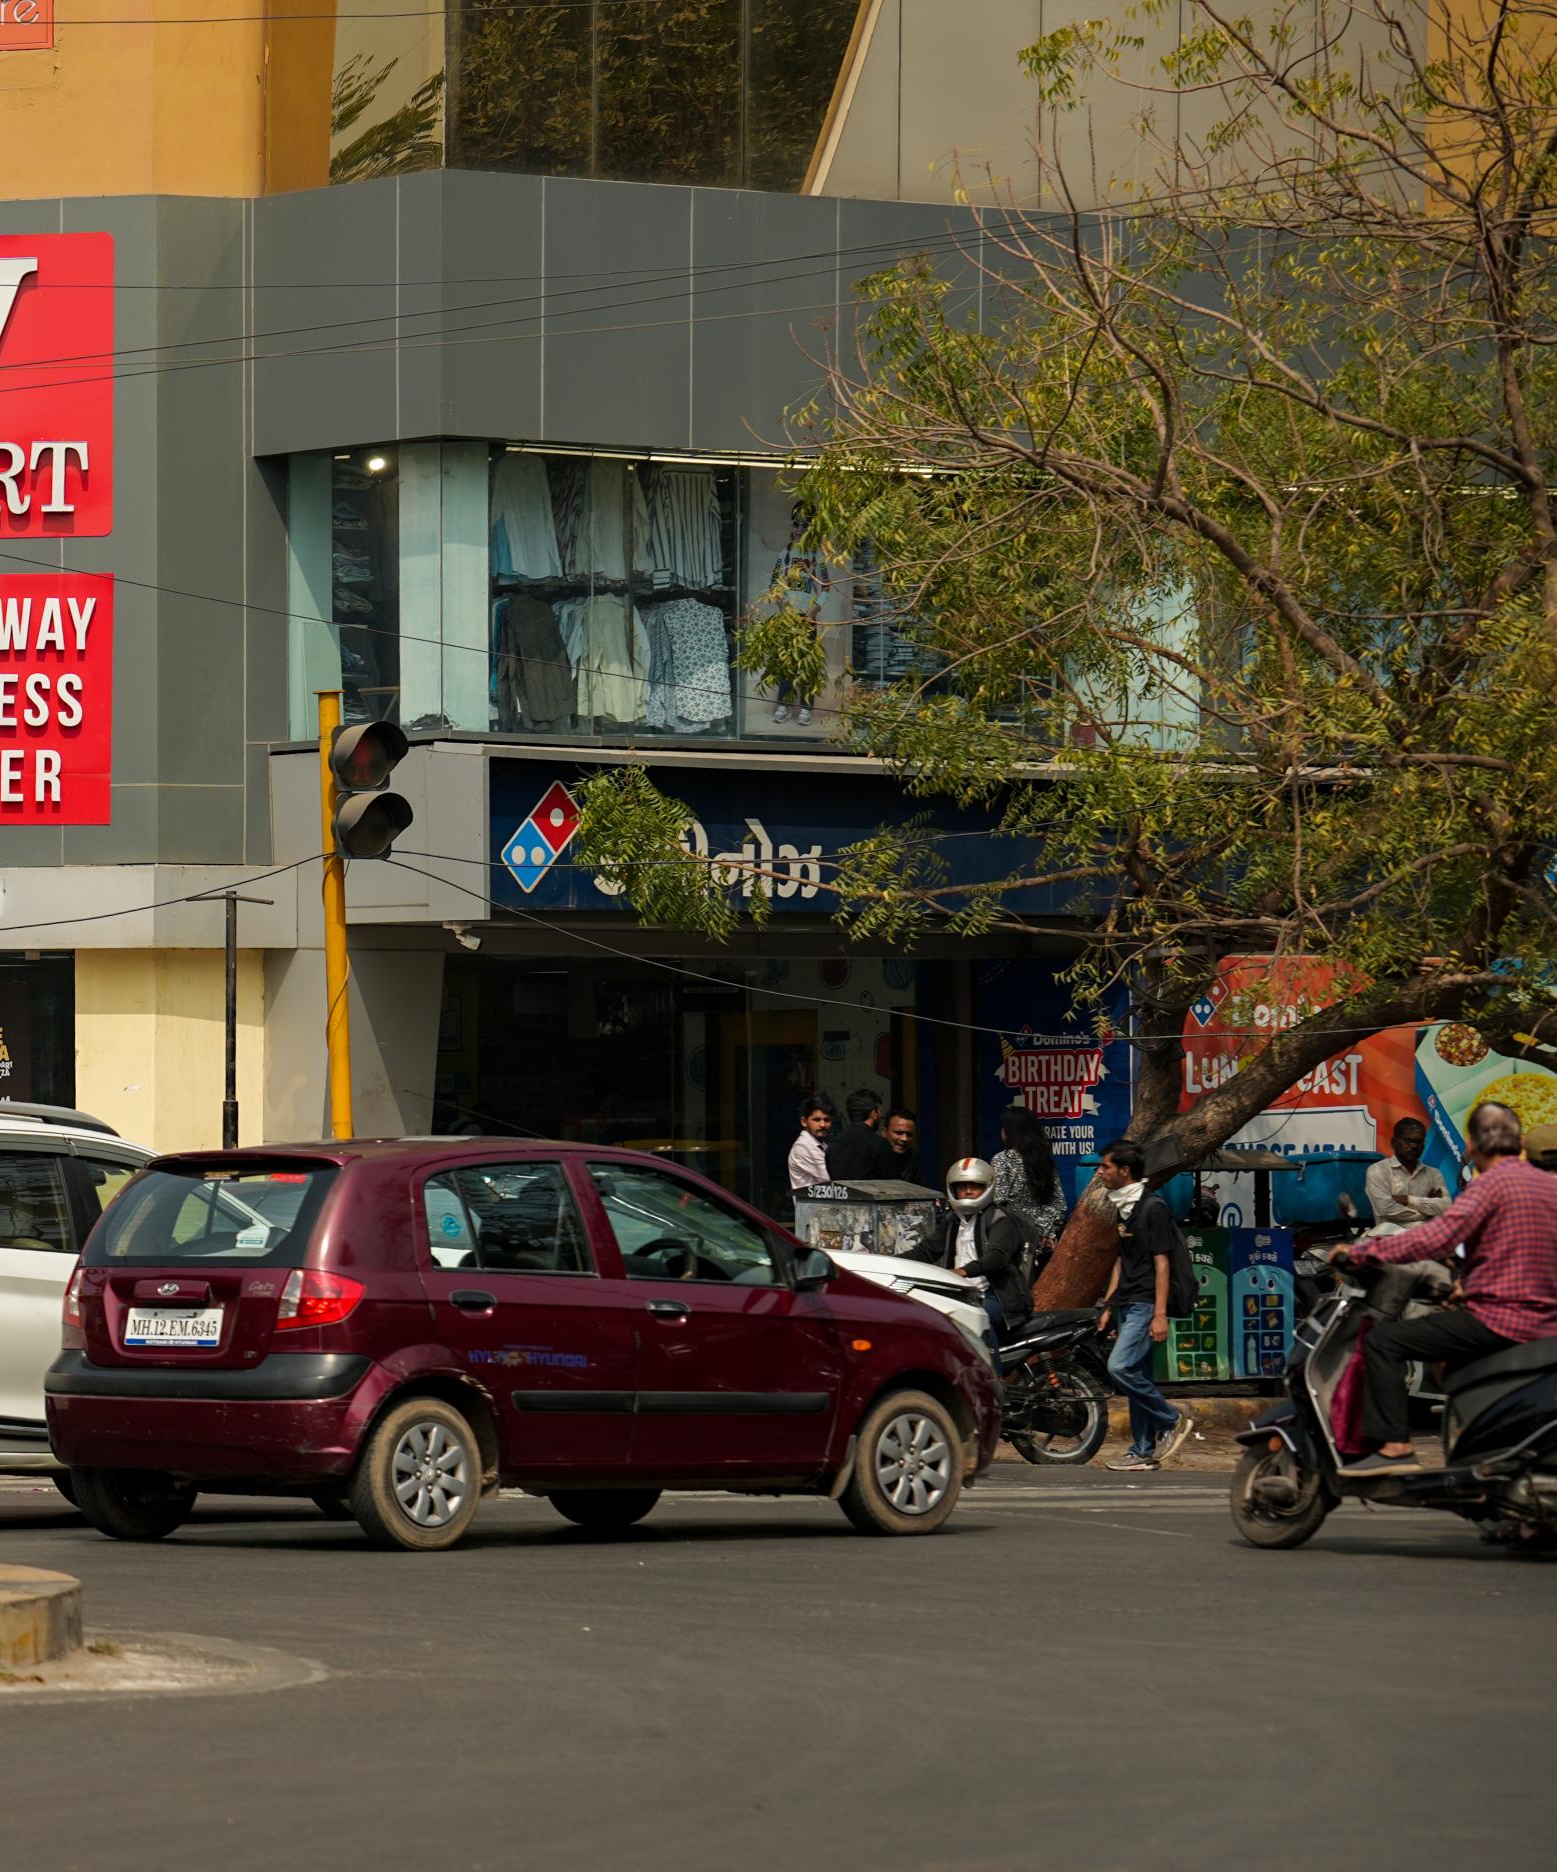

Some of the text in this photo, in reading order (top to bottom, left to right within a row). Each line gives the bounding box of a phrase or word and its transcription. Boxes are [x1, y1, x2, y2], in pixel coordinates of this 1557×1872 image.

[1008, 1053, 1100, 1083] BIRTHDAY
[1025, 1085, 1083, 1113] TREAT
[1069, 1125, 1095, 1139] YOUR
[1052, 1141, 1077, 1155] WITH
